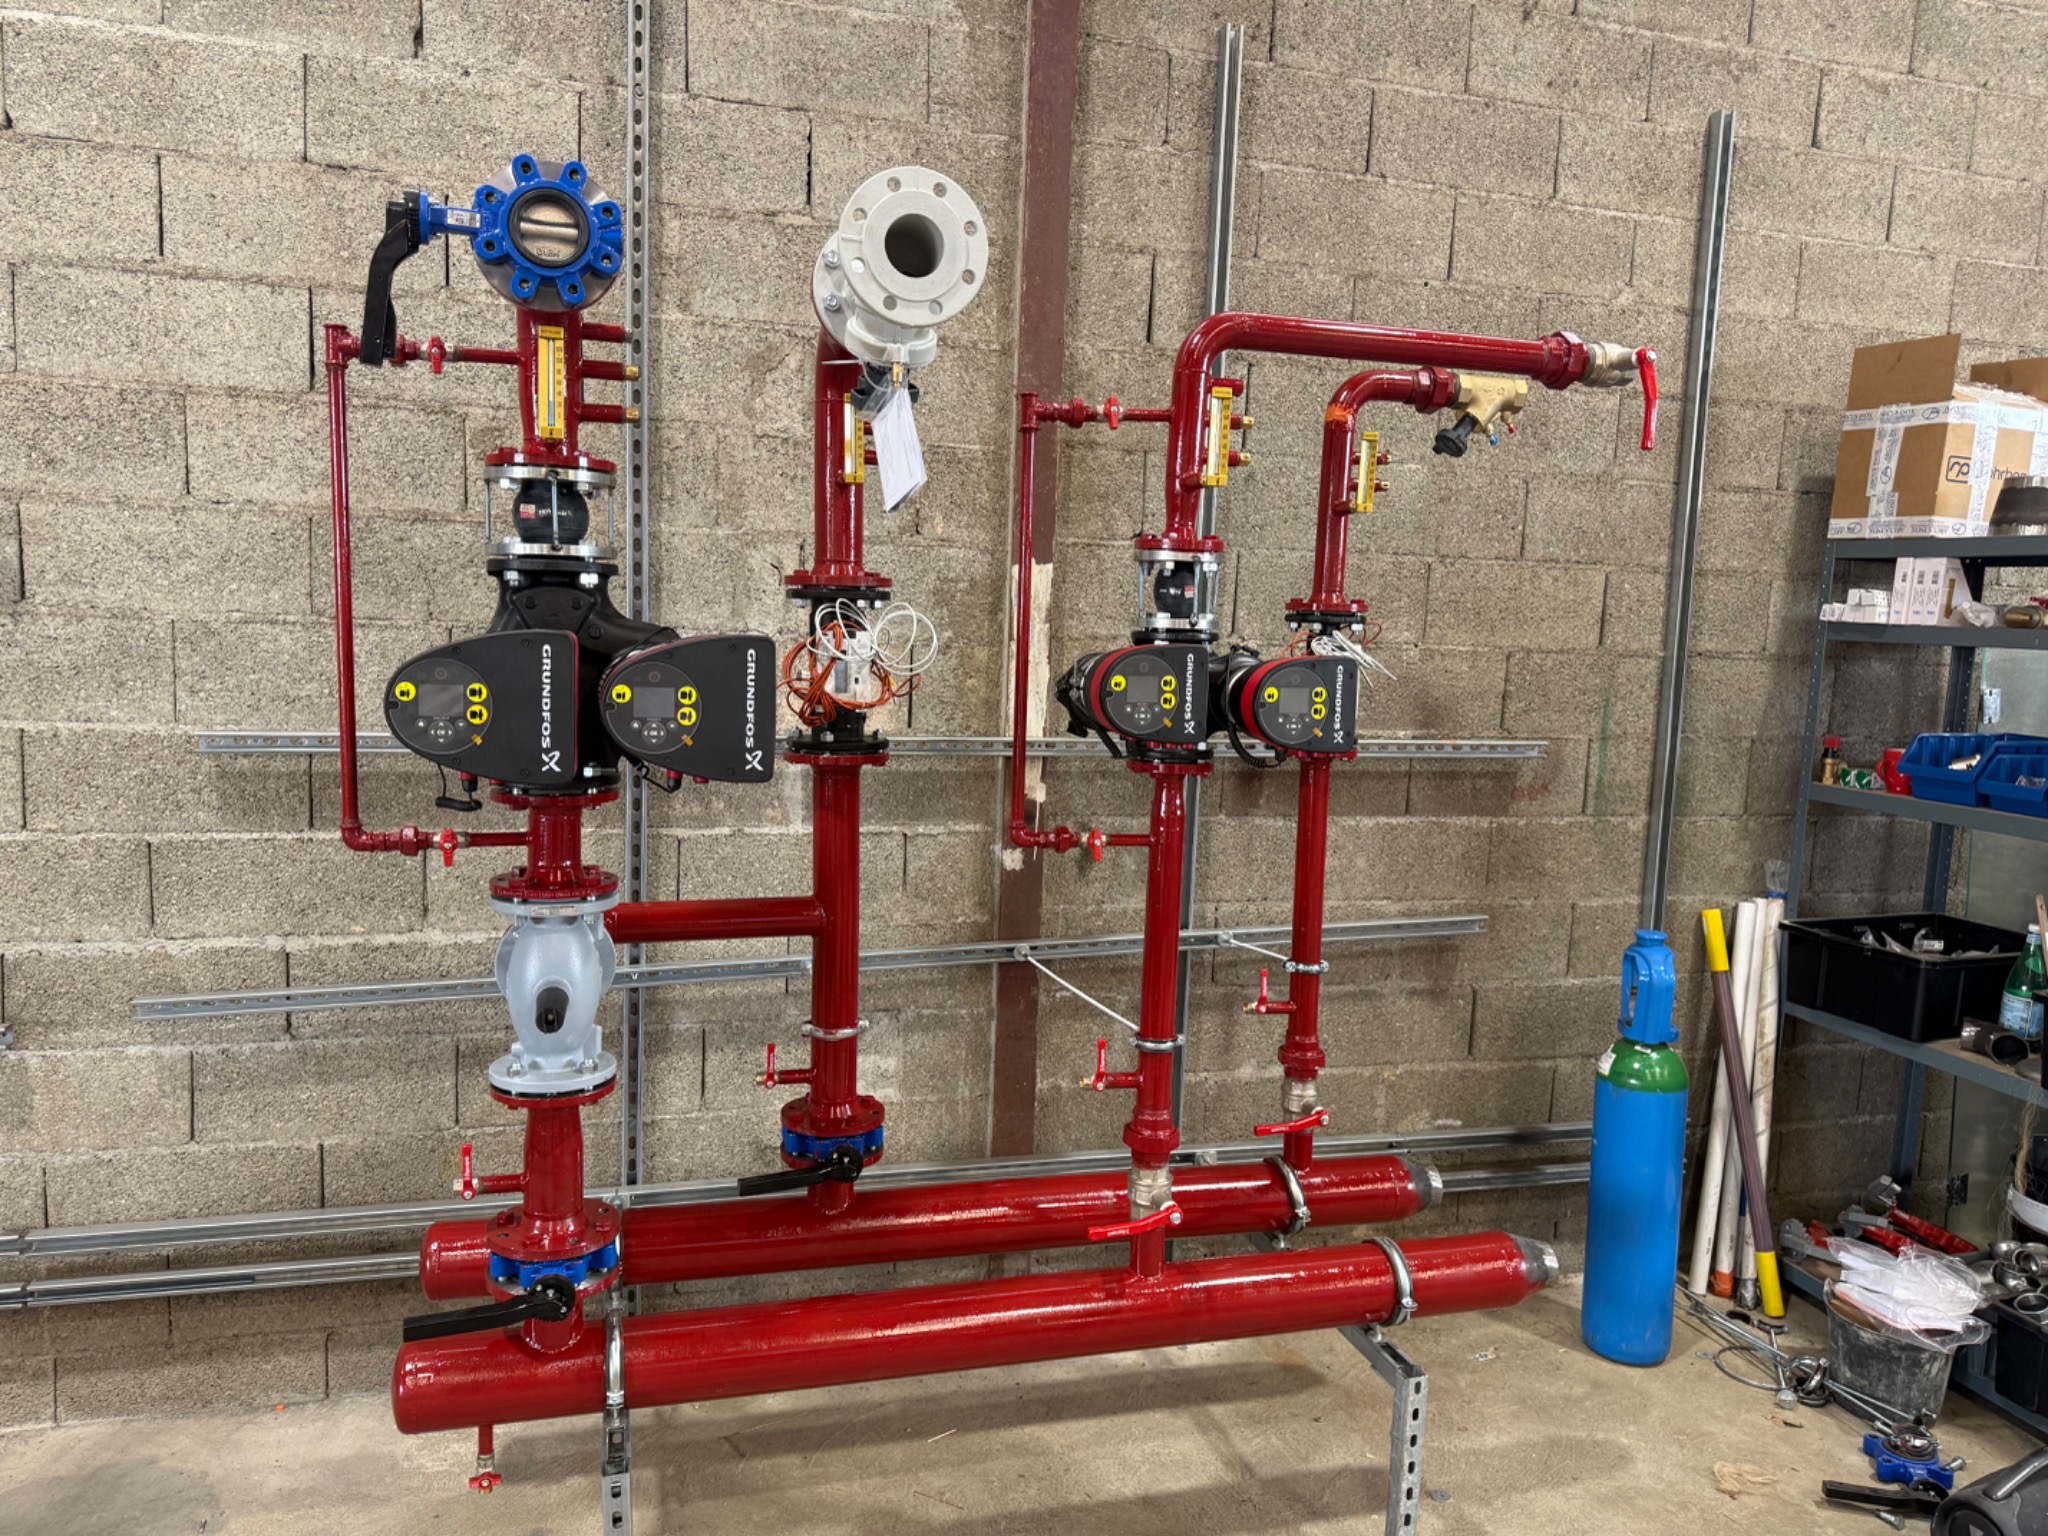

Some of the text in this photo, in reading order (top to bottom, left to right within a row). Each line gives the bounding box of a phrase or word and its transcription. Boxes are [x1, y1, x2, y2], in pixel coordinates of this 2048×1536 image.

[541, 643, 552, 749] GRUNDFOS
[745, 648, 757, 748] GRUNDFOS
[1184, 653, 1194, 720] GRUNDFOS
[1333, 664, 1344, 730] GRUNDFOS
